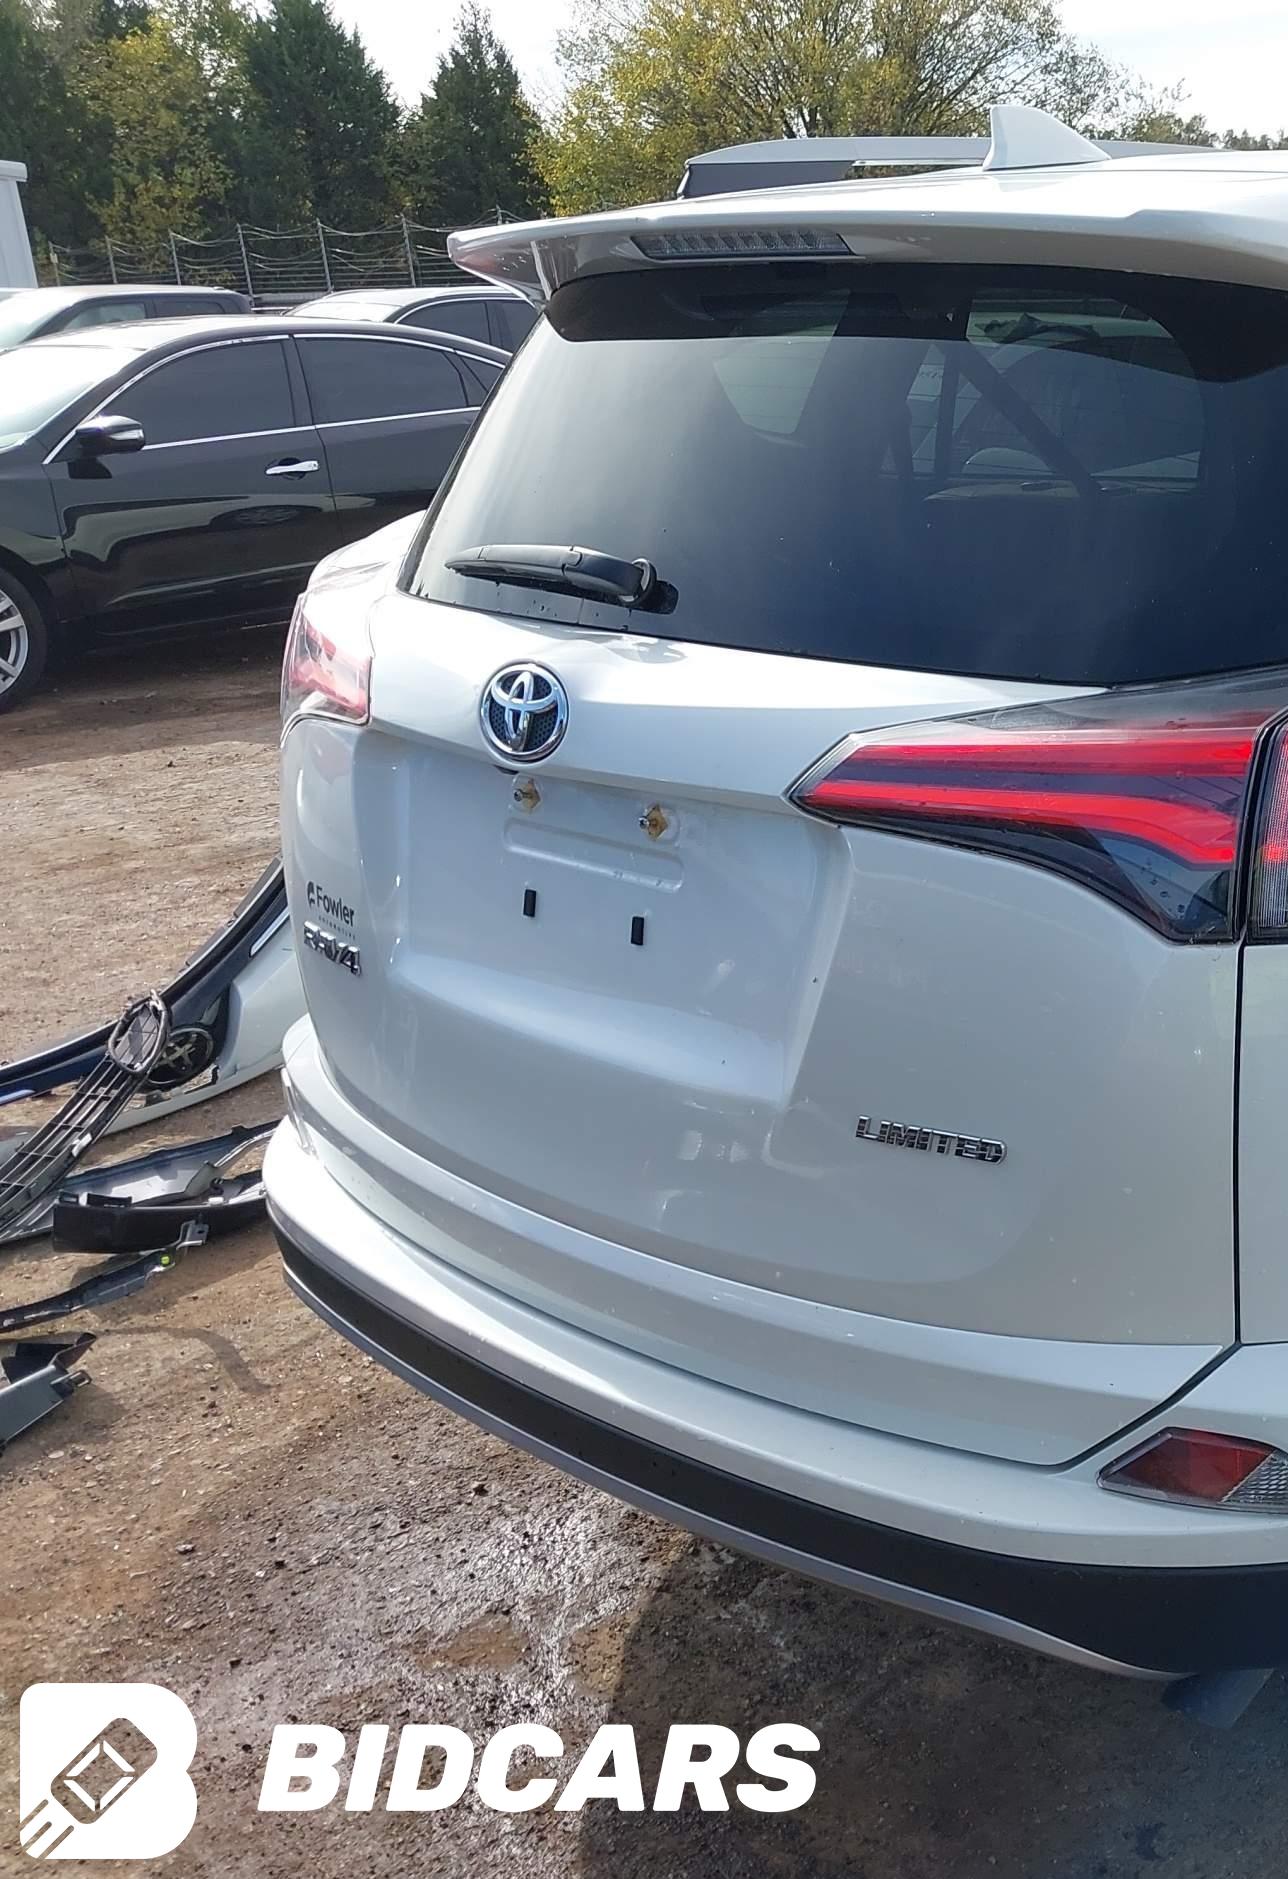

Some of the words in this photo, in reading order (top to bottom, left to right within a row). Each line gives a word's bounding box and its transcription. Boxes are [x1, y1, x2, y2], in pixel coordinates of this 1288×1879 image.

[316, 885, 355, 927] Fowler
[303, 920, 362, 976] RAV4
[855, 1114, 1007, 1165] LIMITED
